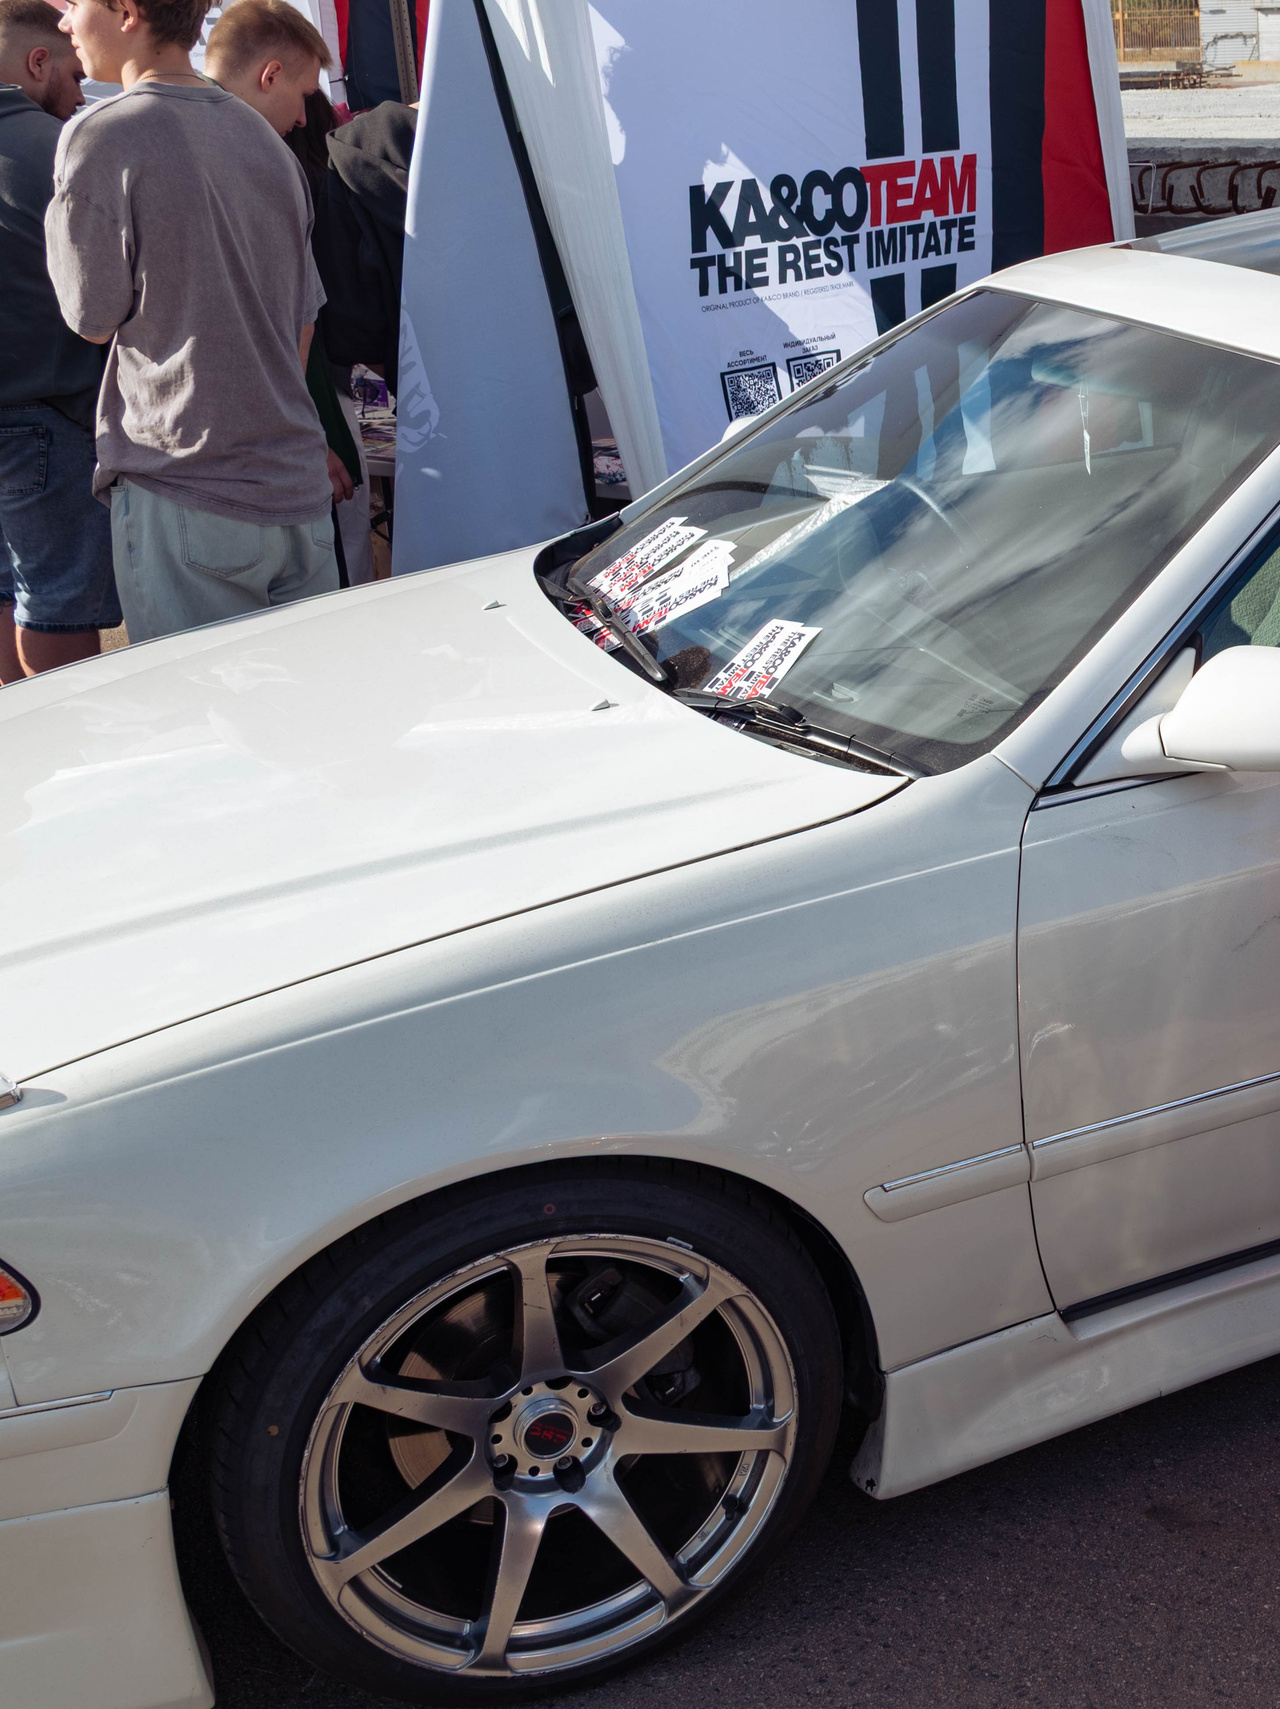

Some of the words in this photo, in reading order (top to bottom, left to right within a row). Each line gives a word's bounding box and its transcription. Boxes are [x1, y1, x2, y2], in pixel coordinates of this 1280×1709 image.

[690, 247, 769, 297] THE
[778, 233, 860, 284] REST
[866, 215, 976, 269] IMITATE
[701, 302, 729, 312] ORIGINAL
[729, 298, 752, 309] PRODUCT
[760, 293, 782, 302] KA&CO
[782, 290, 800, 299] BRAND
[804, 286, 830, 297] REGISTERED
[783, 333, 836, 349] ИНДИВИДУАЛЬНЫЙ
[739, 349, 754, 358] ВЕСЬ
[802, 345, 818, 354] ЗАКАЗ
[727, 355, 768, 368] АССОРТИМЕНТ
